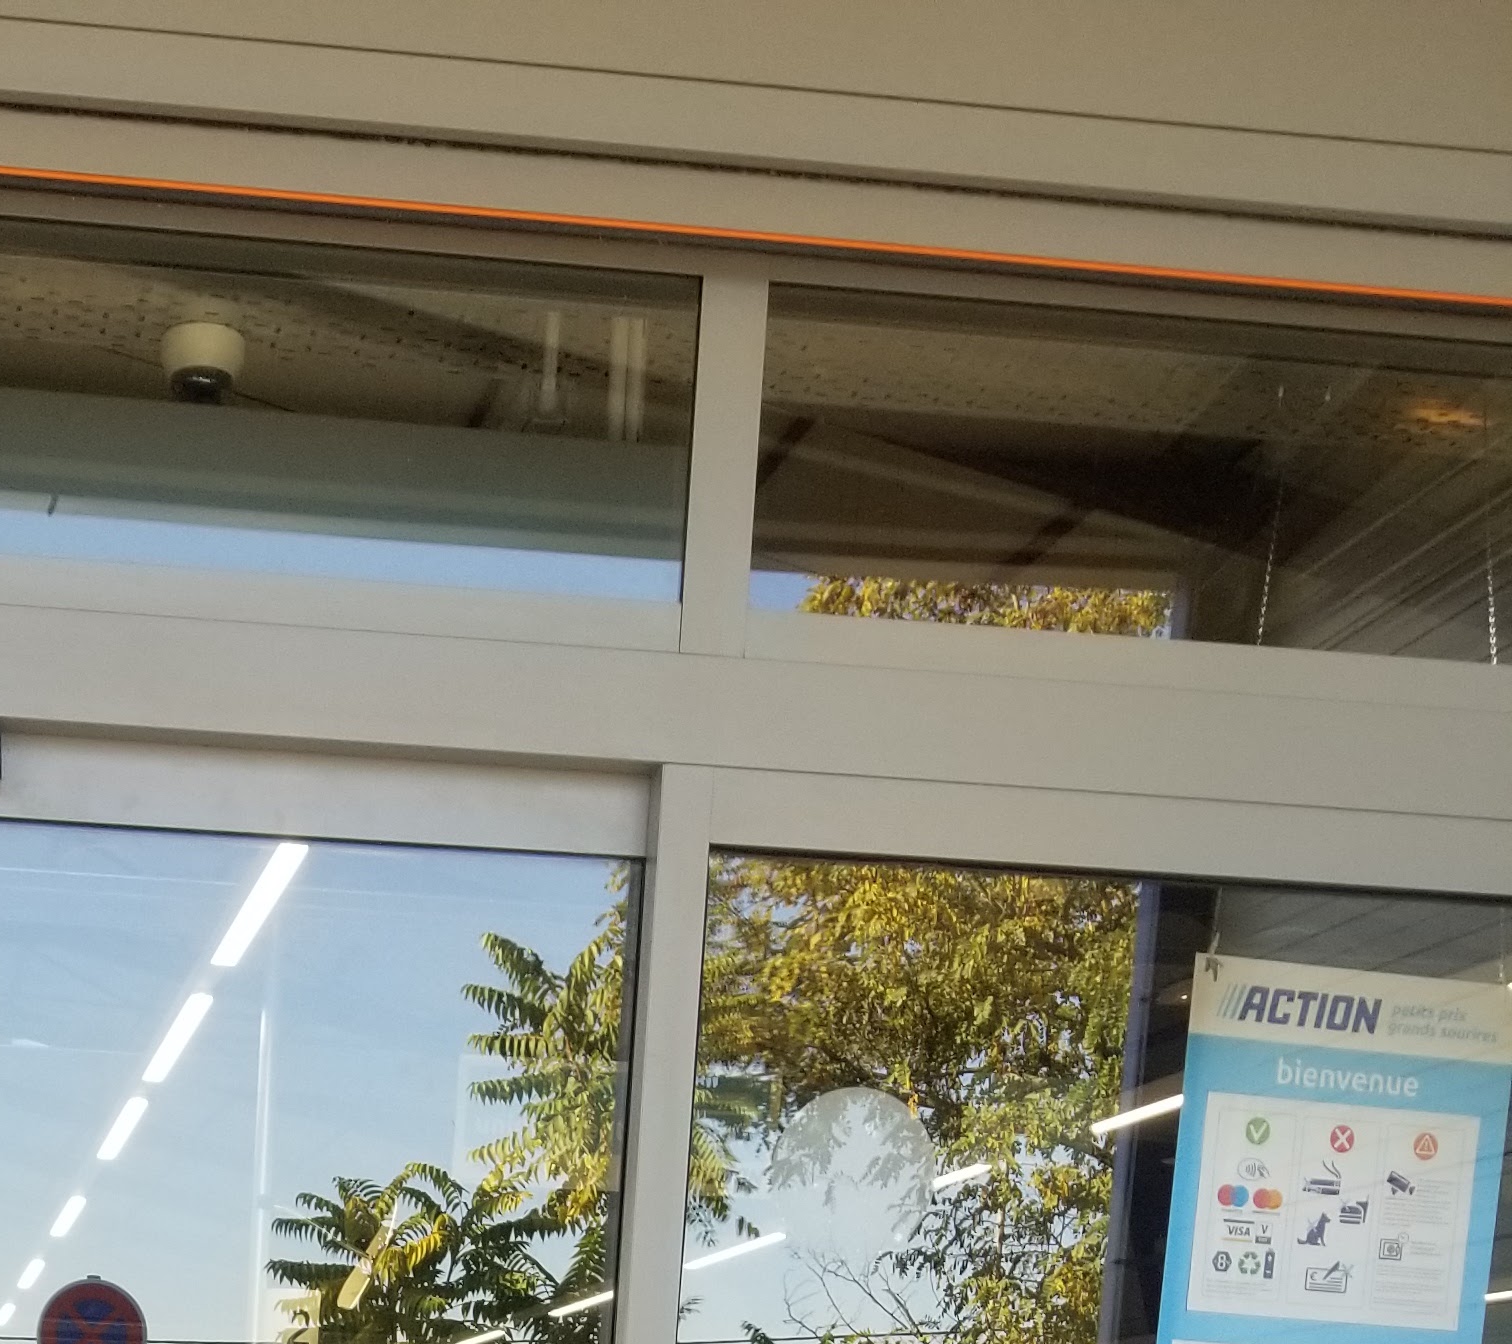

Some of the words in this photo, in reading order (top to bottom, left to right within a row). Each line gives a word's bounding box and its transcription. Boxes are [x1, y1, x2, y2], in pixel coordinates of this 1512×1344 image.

[1238, 985, 1383, 1034] ACTION
[1276, 1056, 1419, 1097] bienvenue
[1227, 1225, 1251, 1236] VISA
